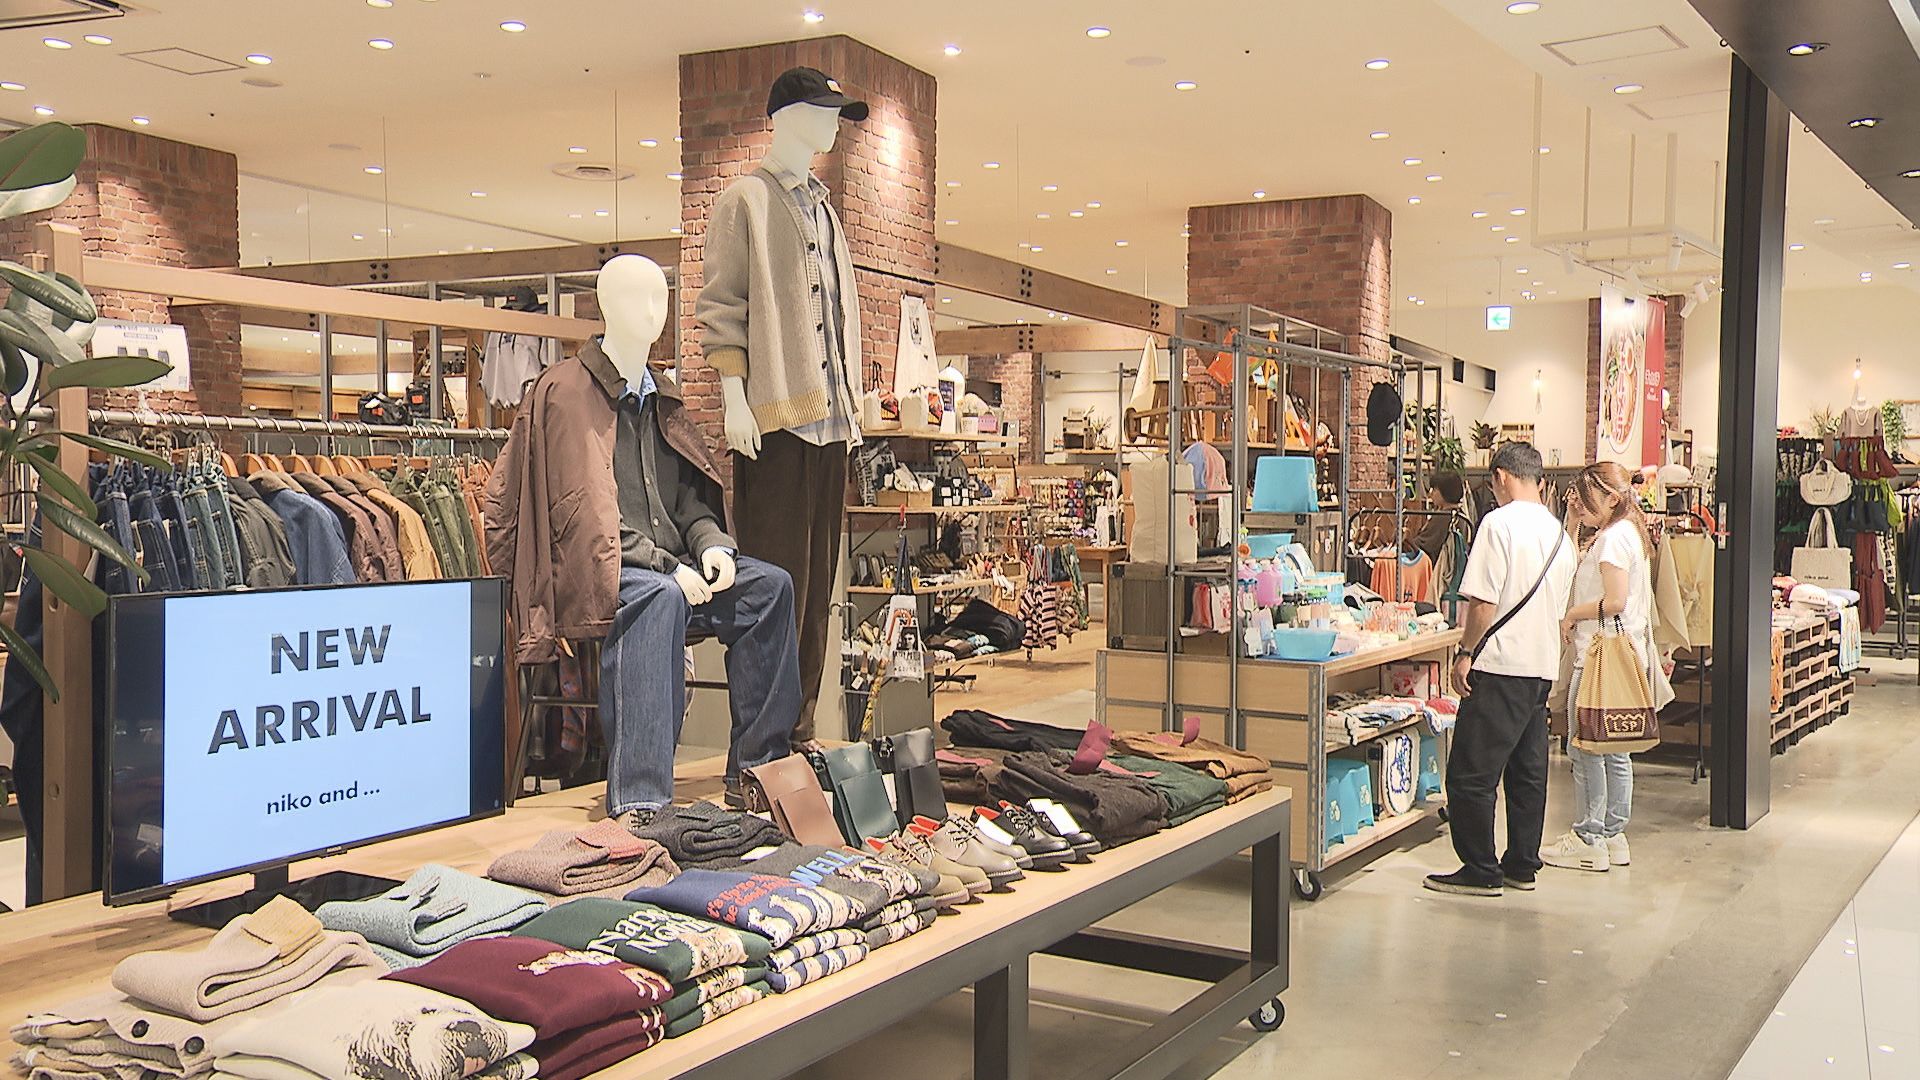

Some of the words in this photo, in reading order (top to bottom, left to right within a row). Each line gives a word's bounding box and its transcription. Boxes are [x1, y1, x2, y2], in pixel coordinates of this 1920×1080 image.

[271, 624, 391, 674] NEW
[207, 686, 431, 754] ARRIVAL
[1613, 720, 1638, 732] LSP
[267, 793, 312, 814] niko
[319, 780, 358, 804] and
